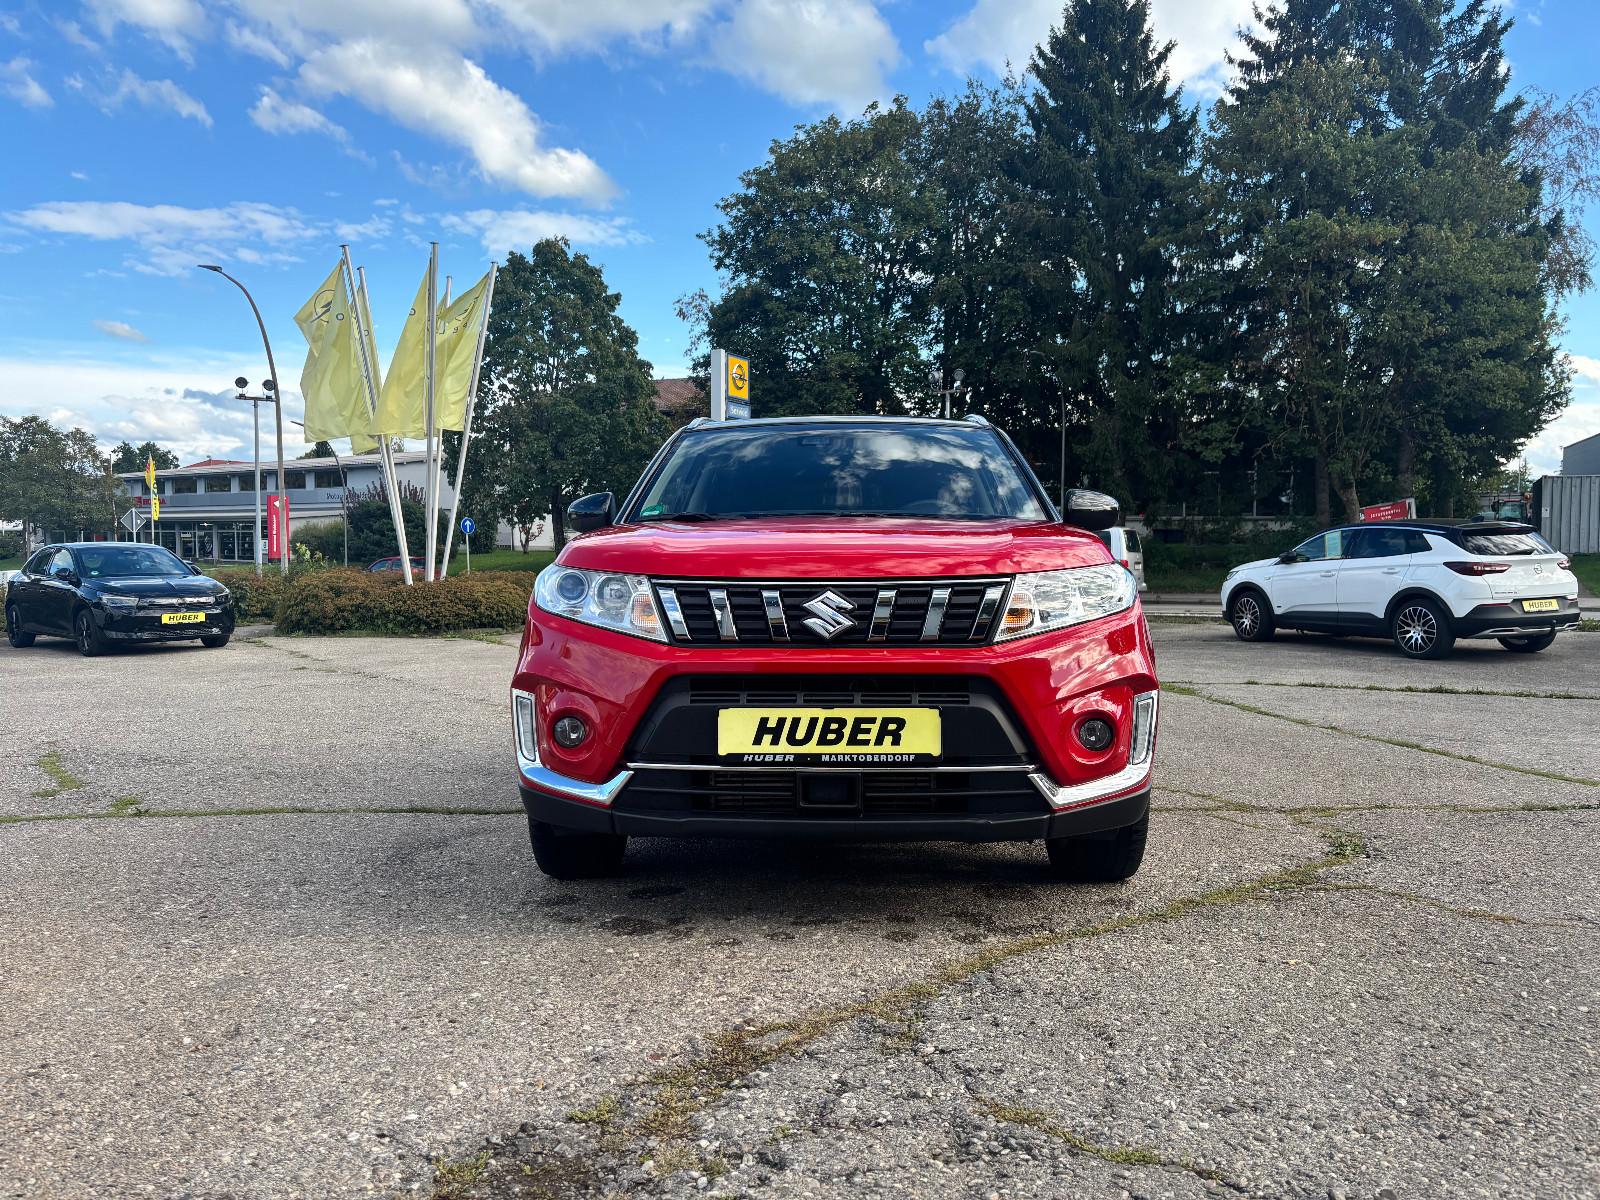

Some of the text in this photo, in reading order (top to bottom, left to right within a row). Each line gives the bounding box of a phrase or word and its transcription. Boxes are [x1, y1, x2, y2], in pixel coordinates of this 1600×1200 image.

[730, 406, 748, 417] Service
[1528, 601, 1554, 609] HUBER
[752, 716, 907, 746] HUBER
[743, 754, 916, 762] HUBER MARKTOBERDORF
